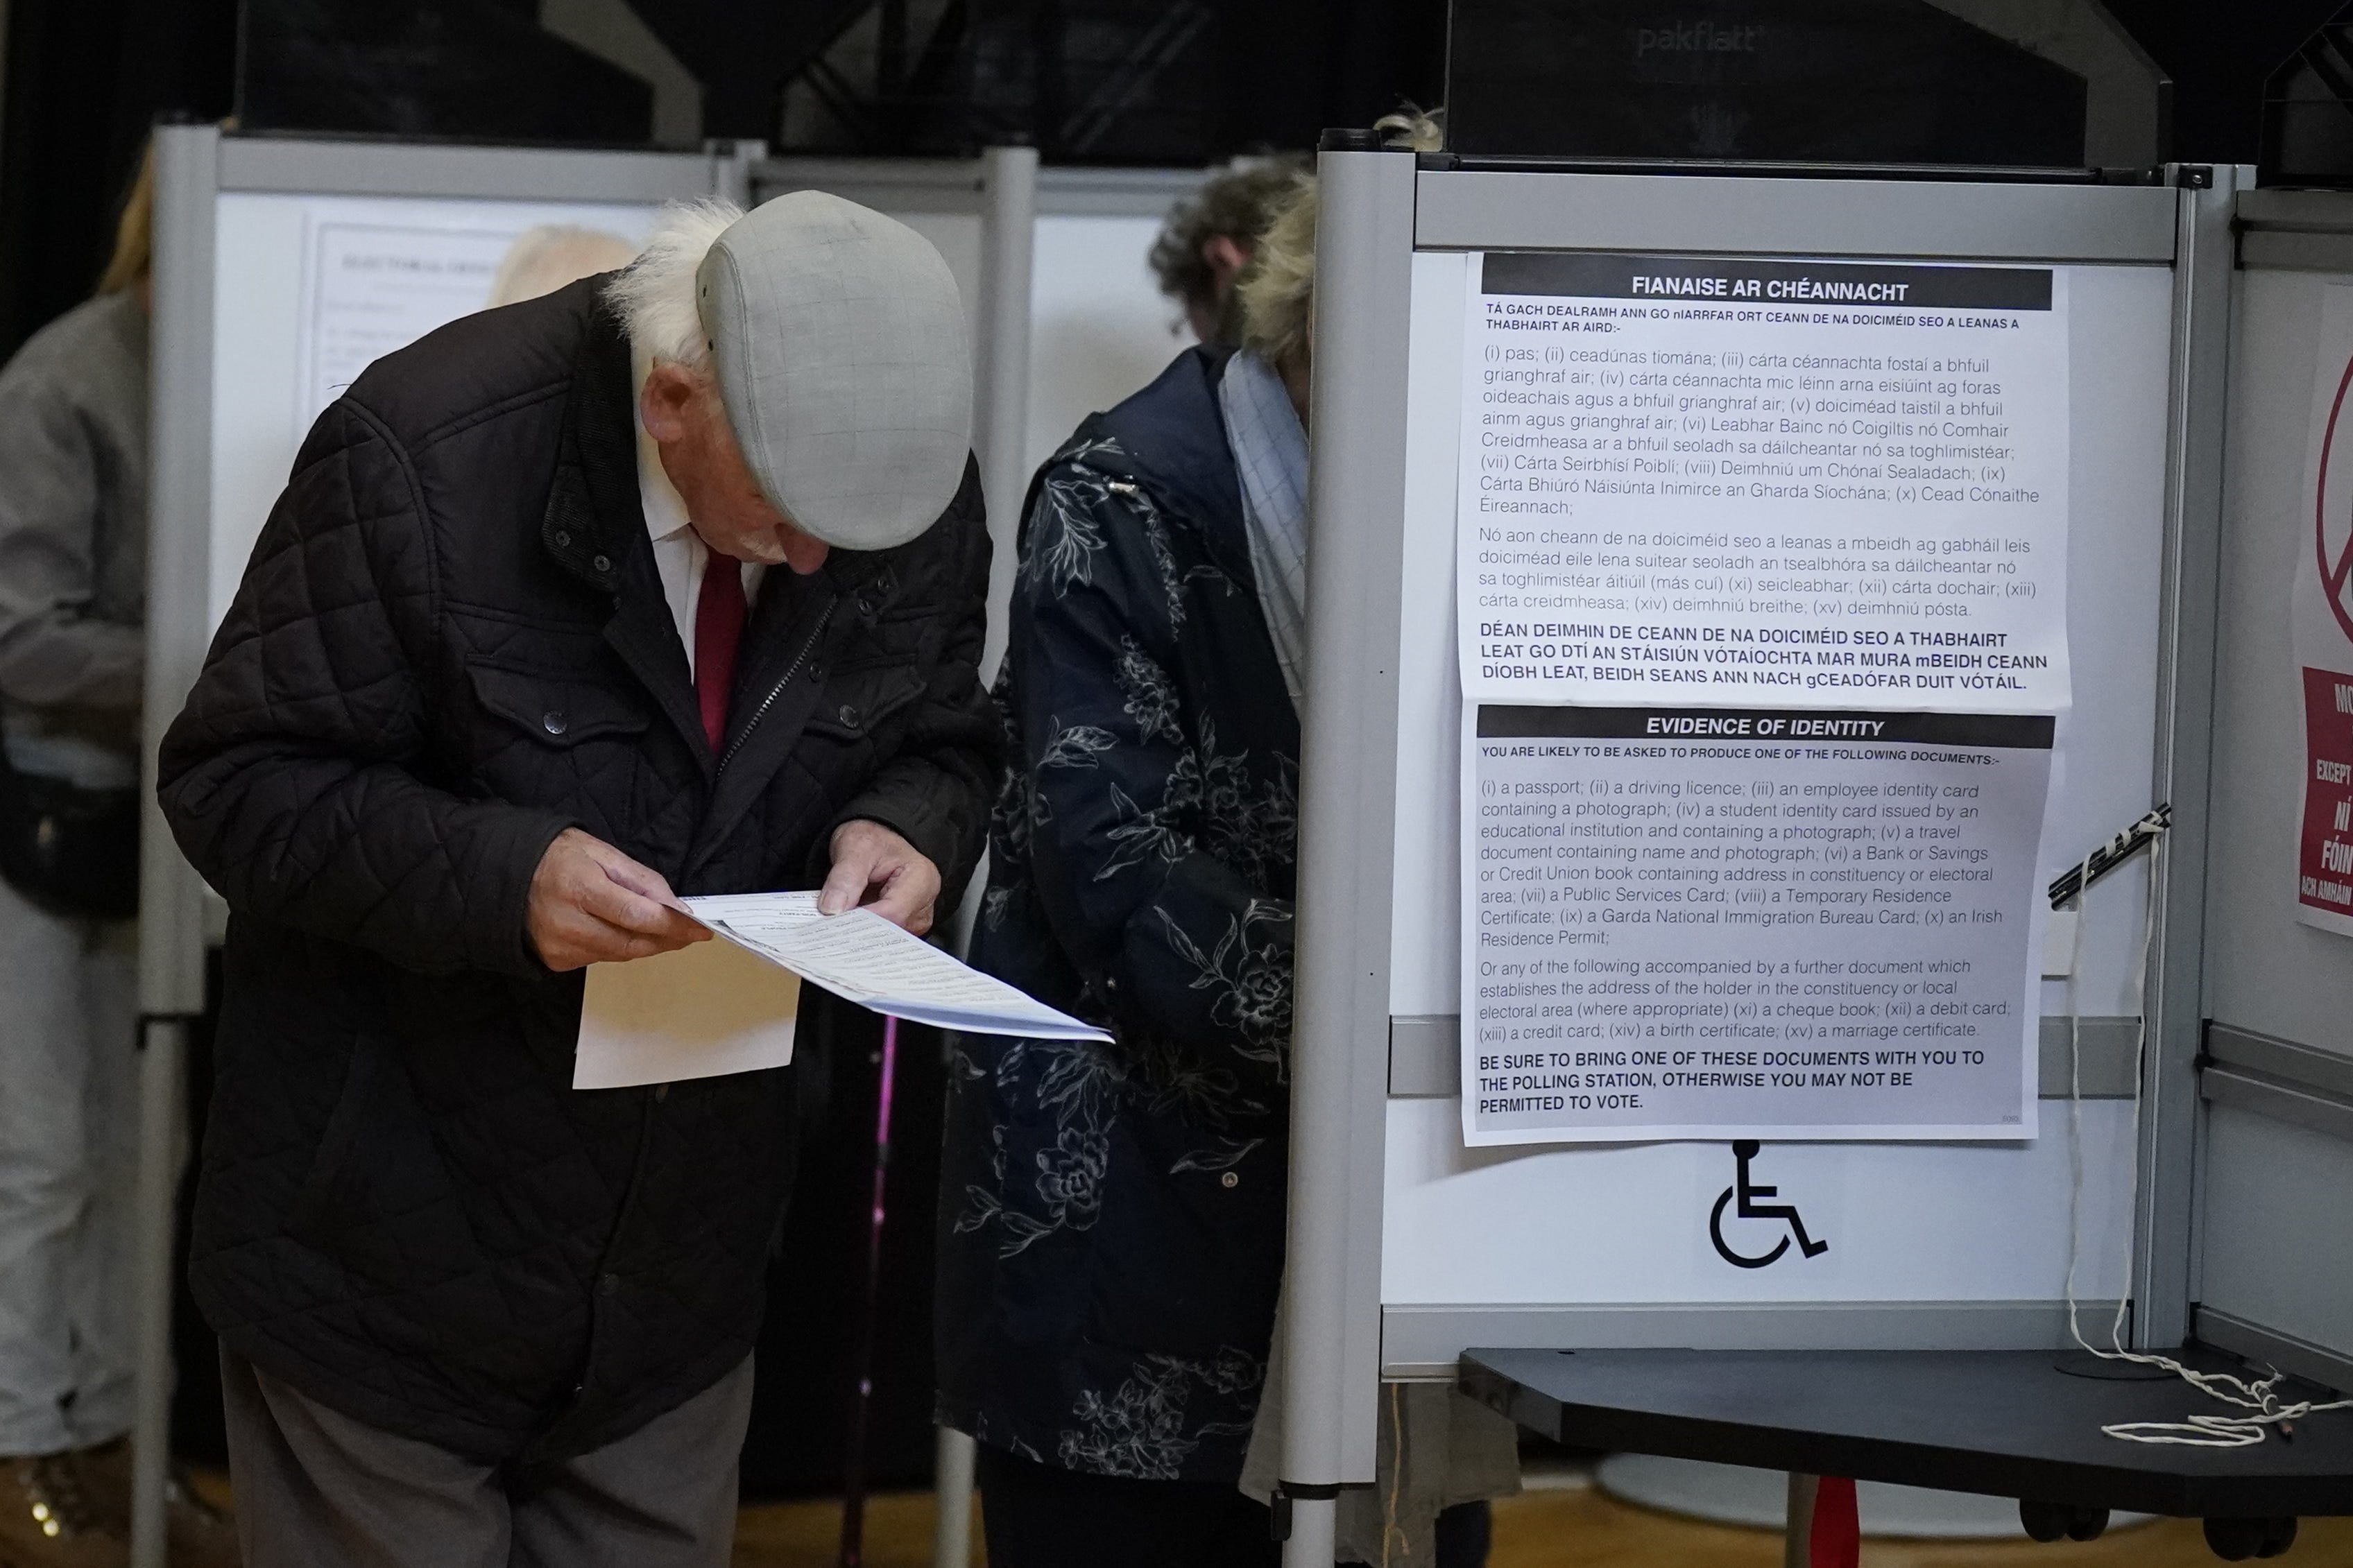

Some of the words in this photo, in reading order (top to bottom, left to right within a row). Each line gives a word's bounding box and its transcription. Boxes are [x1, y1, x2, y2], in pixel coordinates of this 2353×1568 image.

[1632, 277, 1727, 295] FIANAISE
[1732, 279, 1761, 297] AR
[1768, 277, 1908, 301] CHÉANNACHT
[1486, 302, 1503, 313] TÁ
[1507, 304, 1543, 315] GACH
[1547, 305, 1617, 318] DEALRAMH
[1620, 308, 1646, 318] ANN
[1650, 309, 1670, 319] GO
[1674, 309, 1734, 321] nIARRFAR
[1737, 311, 1763, 322] ORT
[1766, 312, 1809, 323] CEANN
[1813, 313, 1829, 324] DE
[1833, 314, 1849, 324] NA
[1853, 313, 1915, 326] DOICIMÉID
[1918, 316, 1944, 327] SEO
[1946, 318, 1955, 327] A
[1958, 318, 2008, 329] LEANAS
[2011, 319, 2019, 329] A
[1486, 319, 1559, 331] THABHAIRT
[1562, 322, 1580, 331] AR
[1583, 322, 1620, 333] AIRD:-
[1485, 345, 1500, 362] (i)
[1506, 349, 1539, 363] pas;
[1546, 347, 1564, 364] (ii)
[1570, 348, 1647, 363] ceadúnas
[1722, 352, 1743, 369] (iii)
[1749, 353, 1787, 368] cárta
[1792, 354, 1881, 370] céannachta
[1888, 356, 1928, 371] fostaí
[1933, 361, 1942, 372] a
[1948, 358, 1989, 372] bhfuil
[1482, 432, 1587, 449] Creidmheasa
[1593, 439, 1609, 449] ar
[1614, 440, 1623, 450] a
[1628, 436, 1668, 451] bhfuil
[1673, 438, 1734, 453] seoladh
[1739, 442, 1756, 454] sa
[1762, 440, 1858, 456] dáilcheantar
[1863, 442, 1881, 456] nó
[1887, 446, 1905, 457] sa
[1480, 593, 1518, 607] cárta
[1524, 594, 1629, 611] creidmheasa;
[1635, 596, 1667, 613] (xiv)
[1673, 597, 1743, 612] deimhniú
[1750, 599, 1807, 614] breithe;
[1813, 600, 1842, 617] (xv)
[1847, 601, 1919, 615] deimhniú
[1480, 619, 1528, 637] DÉAN
[1534, 623, 1604, 638] DEIMHIN
[1610, 626, 1633, 639] DE
[1638, 626, 1697, 641] CEANN
[1703, 628, 1725, 641] DE
[1731, 628, 1754, 642] NA
[1759, 627, 1848, 644] DOICIMÉID
[1854, 631, 1889, 645] SEO
[1893, 632, 1905, 645] A
[1909, 632, 2008, 647] THABHAIRT
[1481, 644, 1524, 657] LEAT
[1530, 644, 1556, 658] GO
[1561, 641, 1587, 658] DTÍ
[1593, 646, 1615, 660] AN
[1620, 644, 1698, 662] STÁISIÚN
[1703, 646, 1813, 665] VÓTAÍOCHTA
[1817, 652, 1854, 666] MAR
[1860, 653, 1911, 667] MURA
[1916, 654, 1982, 669] mBEIDH
[1987, 655, 2047, 669] CEANN
[1482, 662, 1537, 679] DÍOBH
[1543, 665, 1588, 682] LEAT,
[1593, 666, 1645, 681] BEIDH
[1650, 669, 1707, 682] SEANS
[1713, 671, 1748, 684] ANN
[1753, 671, 1802, 685] NACH
[1806, 670, 1911, 689] gCEADÓFAR
[1917, 675, 1955, 689] DUIT
[1959, 672, 2027, 689] VÓTÁIL.
[1648, 718, 1751, 734] EVIDENCE
[1757, 719, 1786, 734] OF
[1790, 720, 1884, 736] IDENTITY
[1482, 747, 1507, 757] YOU
[1510, 746, 1535, 757] ARE
[1539, 746, 1580, 757] LIKELY
[1583, 746, 1600, 757] TO
[1604, 747, 1620, 757] BE
[1623, 747, 1666, 757] ASKED
[1670, 748, 1687, 758] TO
[1691, 748, 1752, 759] PRODUCE
[1755, 748, 1781, 759] ONE
[1784, 749, 1802, 759] OF
[1805, 749, 1829, 759] THE
[1833, 750, 1906, 760] FOLLOWING
[1910, 751, 2000, 765] DOCUMENTS:-
[2316, 759, 2352, 786] EXCEPT
[1481, 871, 1494, 881] or
[1500, 866, 1542, 881] Credit
[1548, 865, 1589, 880] Union
[1595, 866, 1633, 880] book
[1638, 867, 1719, 884] containing
[1724, 867, 1786, 881] address
[1792, 868, 1804, 881] in
[1810, 868, 1906, 885] constituency
[1910, 870, 1924, 881] or
[1929, 868, 1992, 881] electoral
[2301, 875, 2317, 897] ACH
[1481, 932, 1554, 945] Residence
[1559, 930, 1609, 946] Permit;
[1480, 1026, 1506, 1044] (xiii)
[1511, 1029, 1519, 1040] a
[1523, 1024, 1562, 1040] credit
[1567, 1023, 1604, 1039] card;
[1610, 1023, 1640, 1040] (xiv)
[1646, 1026, 1654, 1037] a
[1661, 1023, 1694, 1037] birth
[1700, 1023, 1779, 1040] certificate;
[1786, 1023, 1813, 1040] (xv)
[1818, 1027, 1826, 1037] a
[1832, 1024, 1898, 1040] marriage
[1903, 1022, 1979, 1037] certificate.
[1480, 1056, 1499, 1070] BE
[1504, 1053, 1544, 1069] SURE
[1548, 1053, 1570, 1067] TO
[1575, 1051, 1626, 1066] BRING
[1632, 1051, 1667, 1065] ONE
[1672, 1051, 1697, 1065] OF
[1700, 1051, 1757, 1065] THESE
[1763, 1051, 1869, 1066] DOCUMENTS
[1875, 1051, 1916, 1065] WITH
[1922, 1051, 1956, 1065] YOU
[1962, 1051, 1984, 1065] TO
[1480, 1076, 1508, 1092] THE
[1513, 1074, 1580, 1090] POLLING
[1585, 1072, 1657, 1089] STATION,
[1663, 1072, 1765, 1087] OTHERWISE
[1770, 1073, 1806, 1087] YOU
[1812, 1073, 1847, 1087] MAY
[1851, 1073, 1885, 1087] NOT
[1890, 1072, 1913, 1086] BE
[1480, 1096, 1564, 1114] PERMITTED
[1569, 1095, 1591, 1110] TO
[1596, 1094, 1643, 1109] VOTE.
